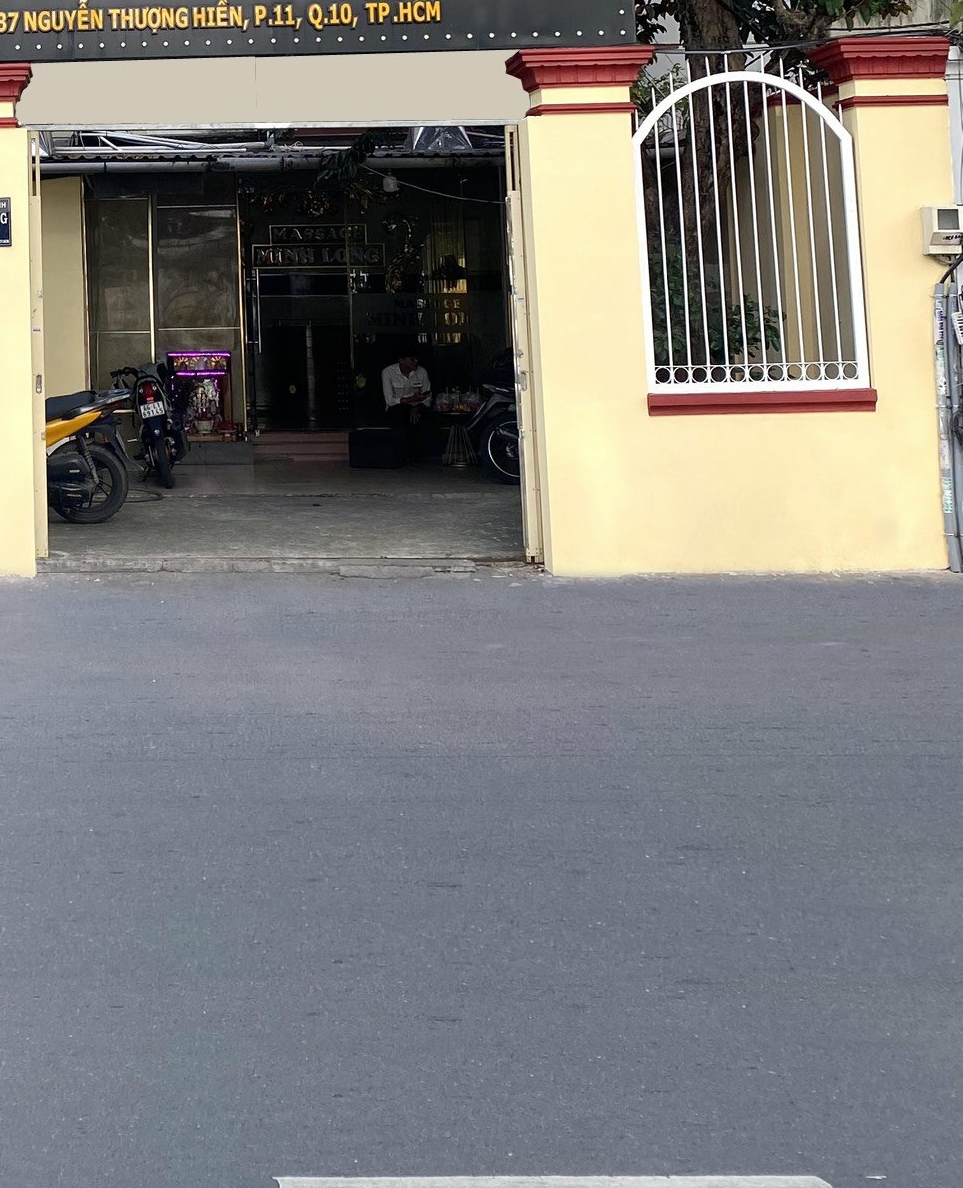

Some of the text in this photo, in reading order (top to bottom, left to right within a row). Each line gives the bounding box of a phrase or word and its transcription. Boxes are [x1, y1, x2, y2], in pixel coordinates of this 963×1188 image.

[108, 6, 188, 34] THƯỢNG
[253, 4, 303, 30] P.11,
[308, 2, 358, 29] Q.10,
